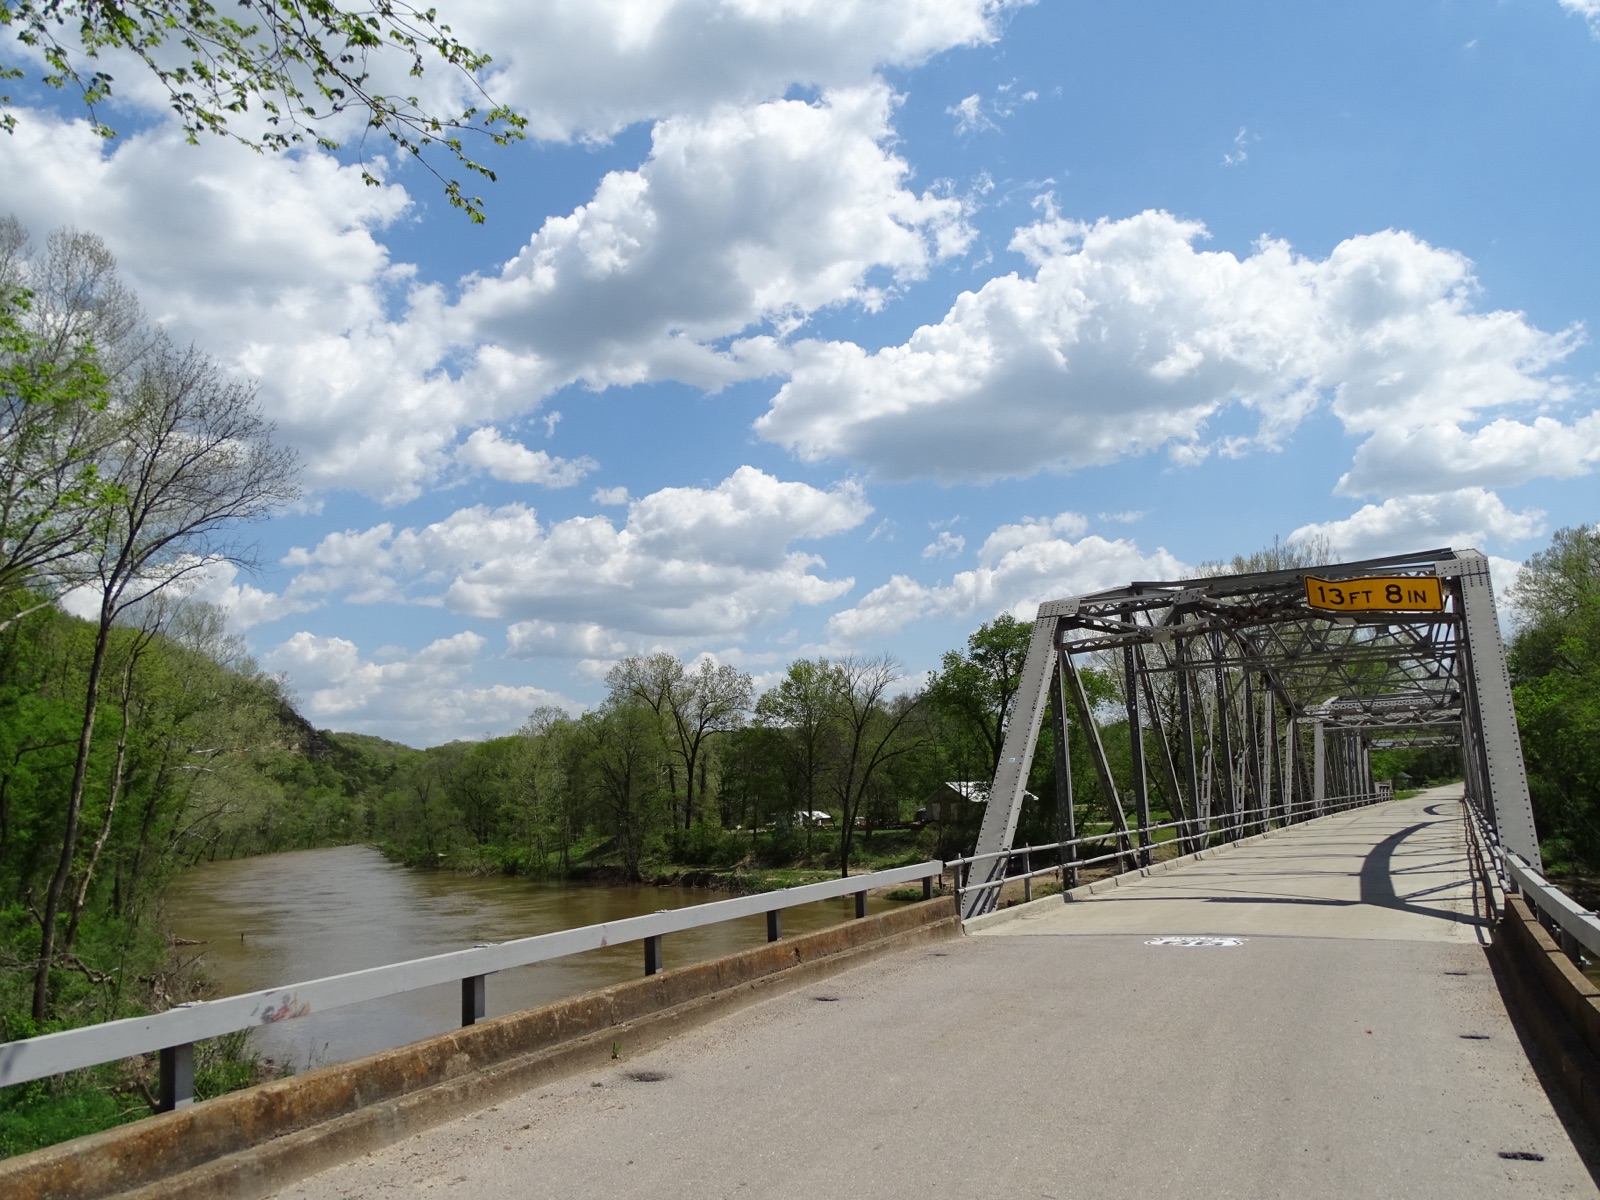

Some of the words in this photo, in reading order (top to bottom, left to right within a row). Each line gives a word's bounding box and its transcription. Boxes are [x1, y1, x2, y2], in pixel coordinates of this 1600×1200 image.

[1317, 586, 1345, 605] 13
[1349, 590, 1372, 604] FT
[1385, 584, 1403, 604] 8
[1408, 590, 1427, 603] IN
